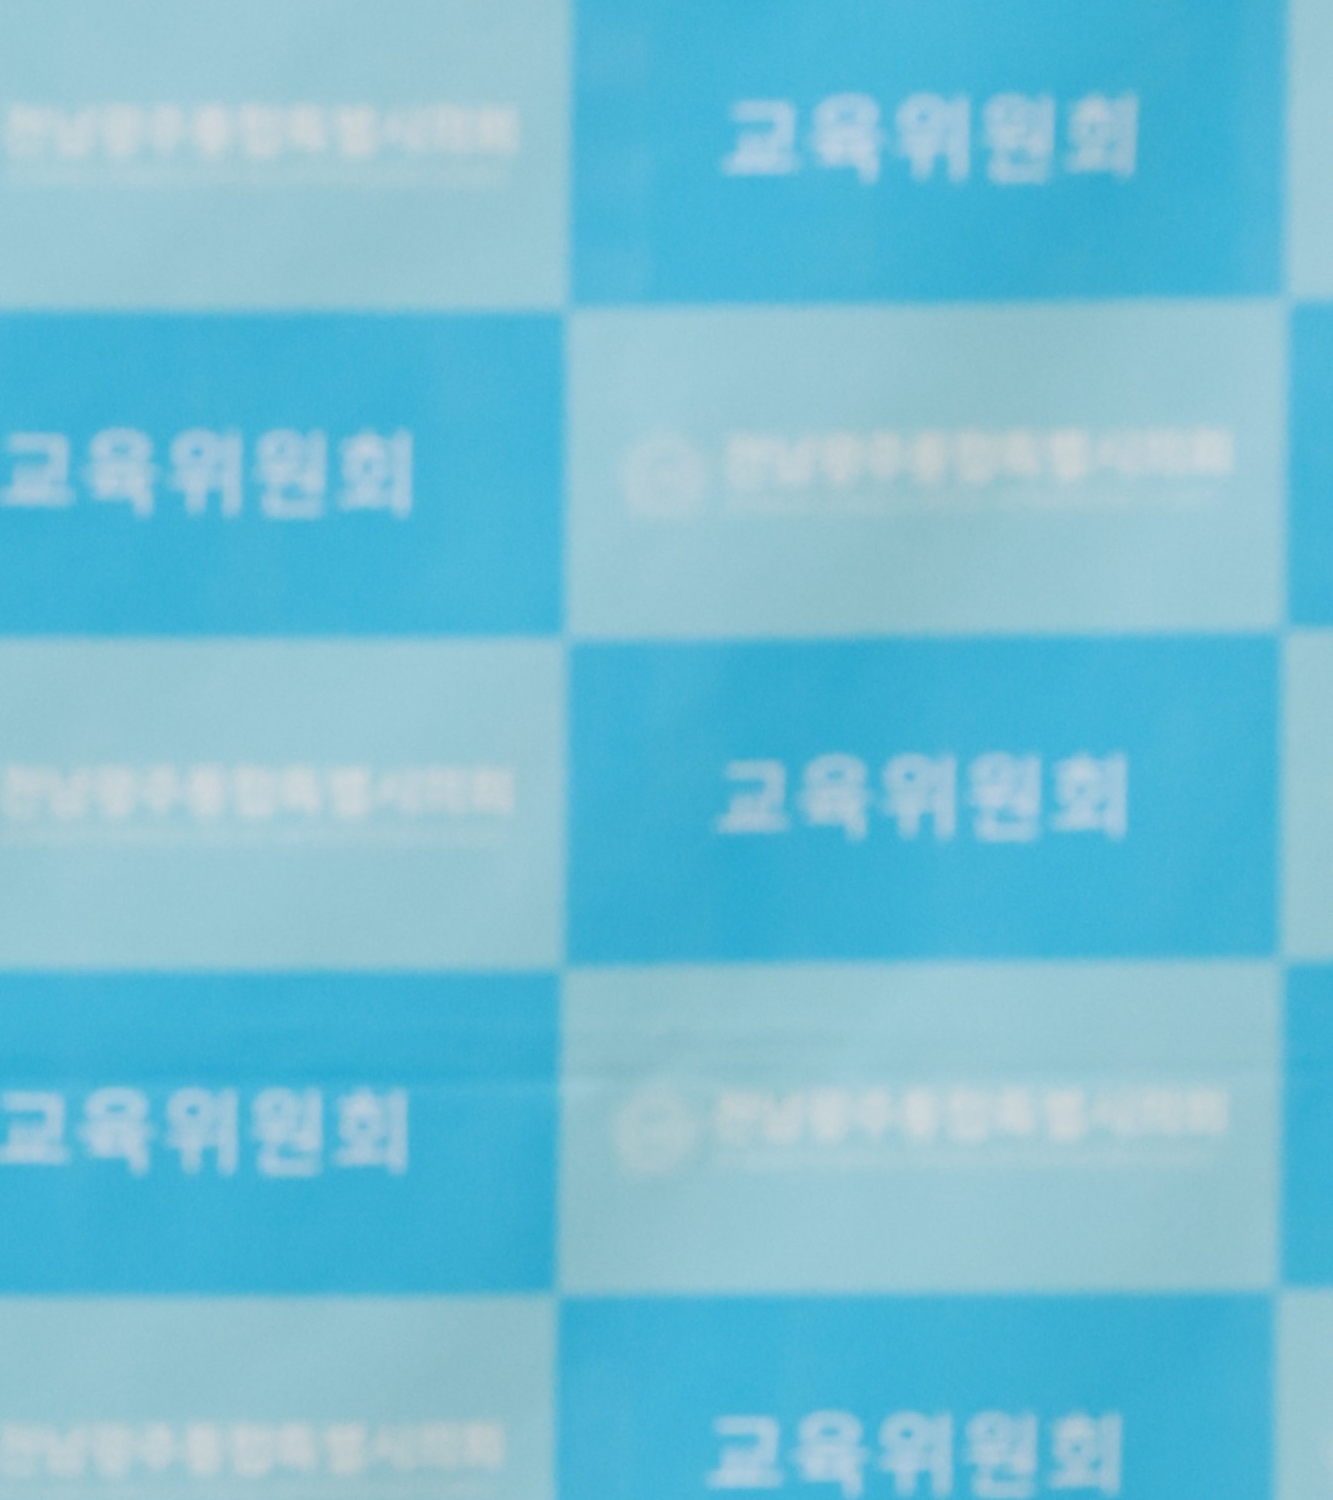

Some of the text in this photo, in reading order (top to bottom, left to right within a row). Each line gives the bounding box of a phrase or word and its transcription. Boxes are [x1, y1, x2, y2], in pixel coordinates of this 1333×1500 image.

[722, 91, 1140, 187] 교육위원회
[716, 749, 1130, 845] 교육위원회
[706, 1407, 1124, 1500] 교육위원회
